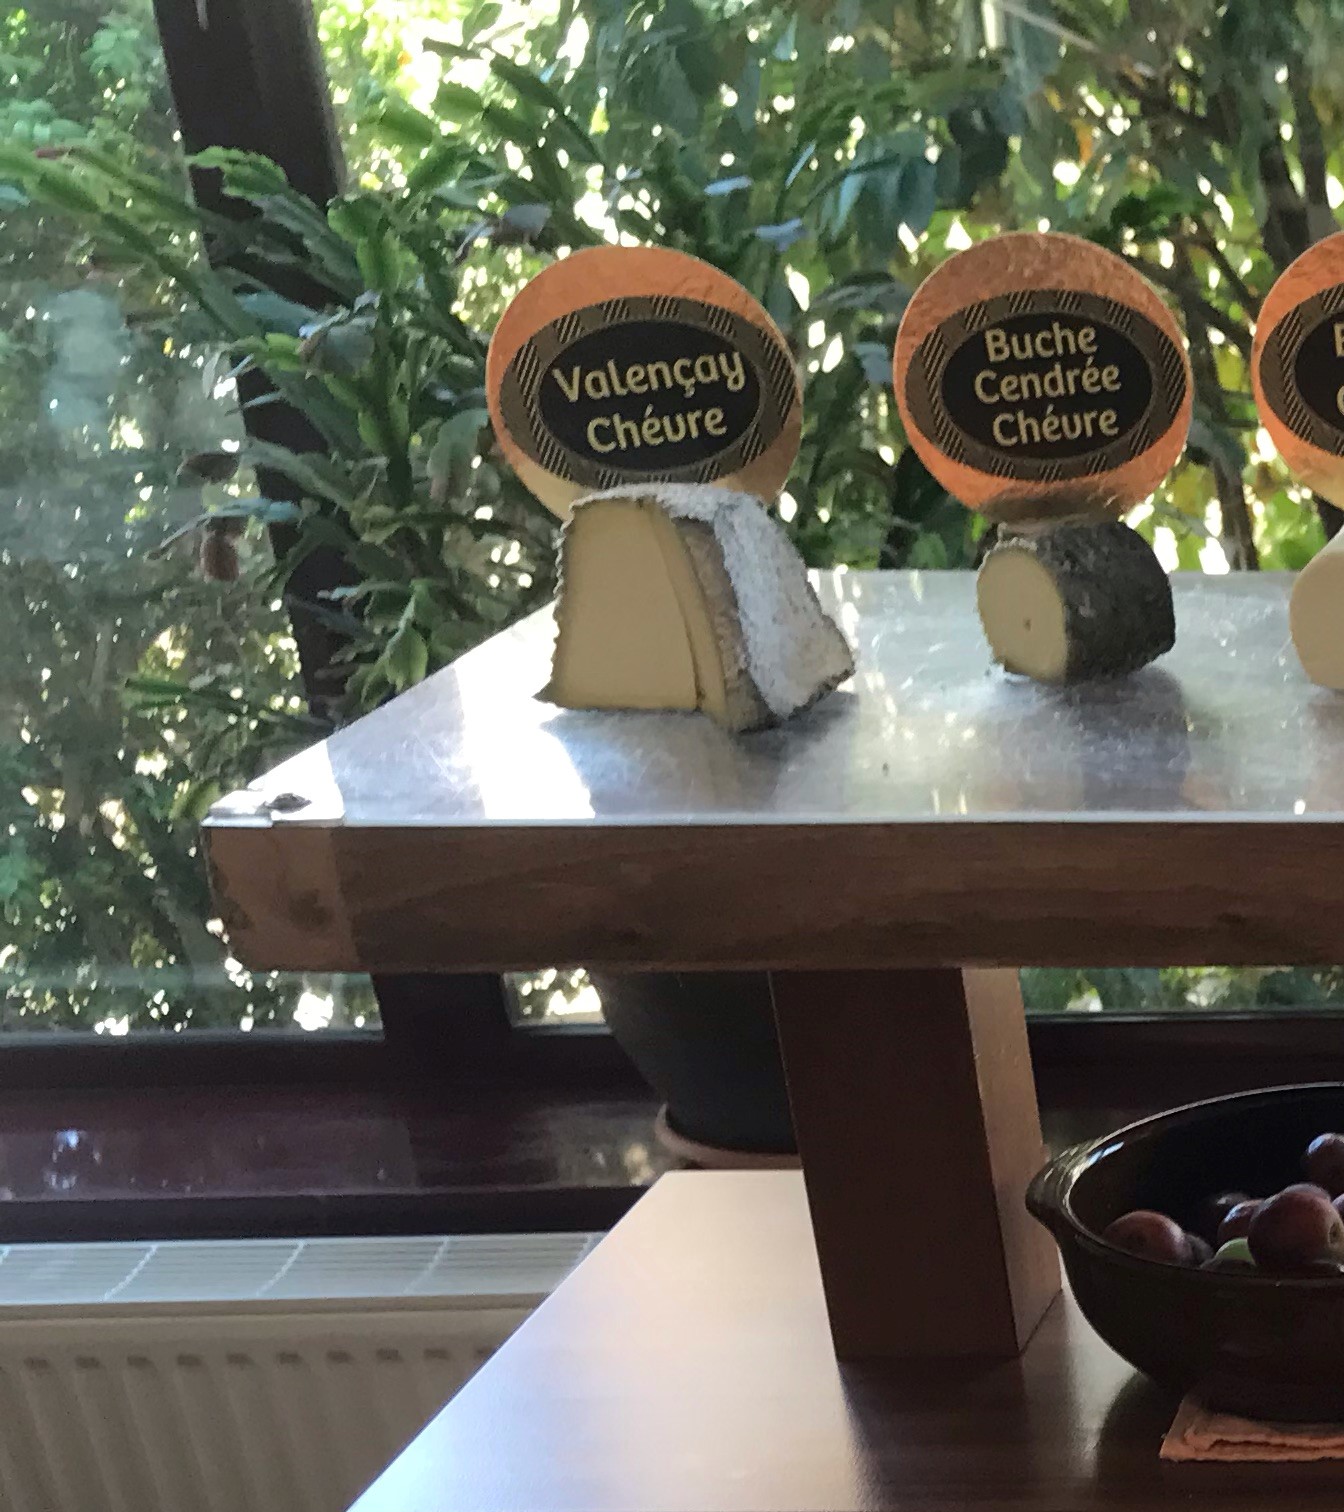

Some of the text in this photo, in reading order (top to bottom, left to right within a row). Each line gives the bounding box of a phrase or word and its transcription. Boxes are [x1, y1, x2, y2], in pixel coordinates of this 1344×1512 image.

[985, 323, 1097, 362] Buche
[553, 350, 746, 403] Valençay
[973, 358, 1121, 404] Cendrée
